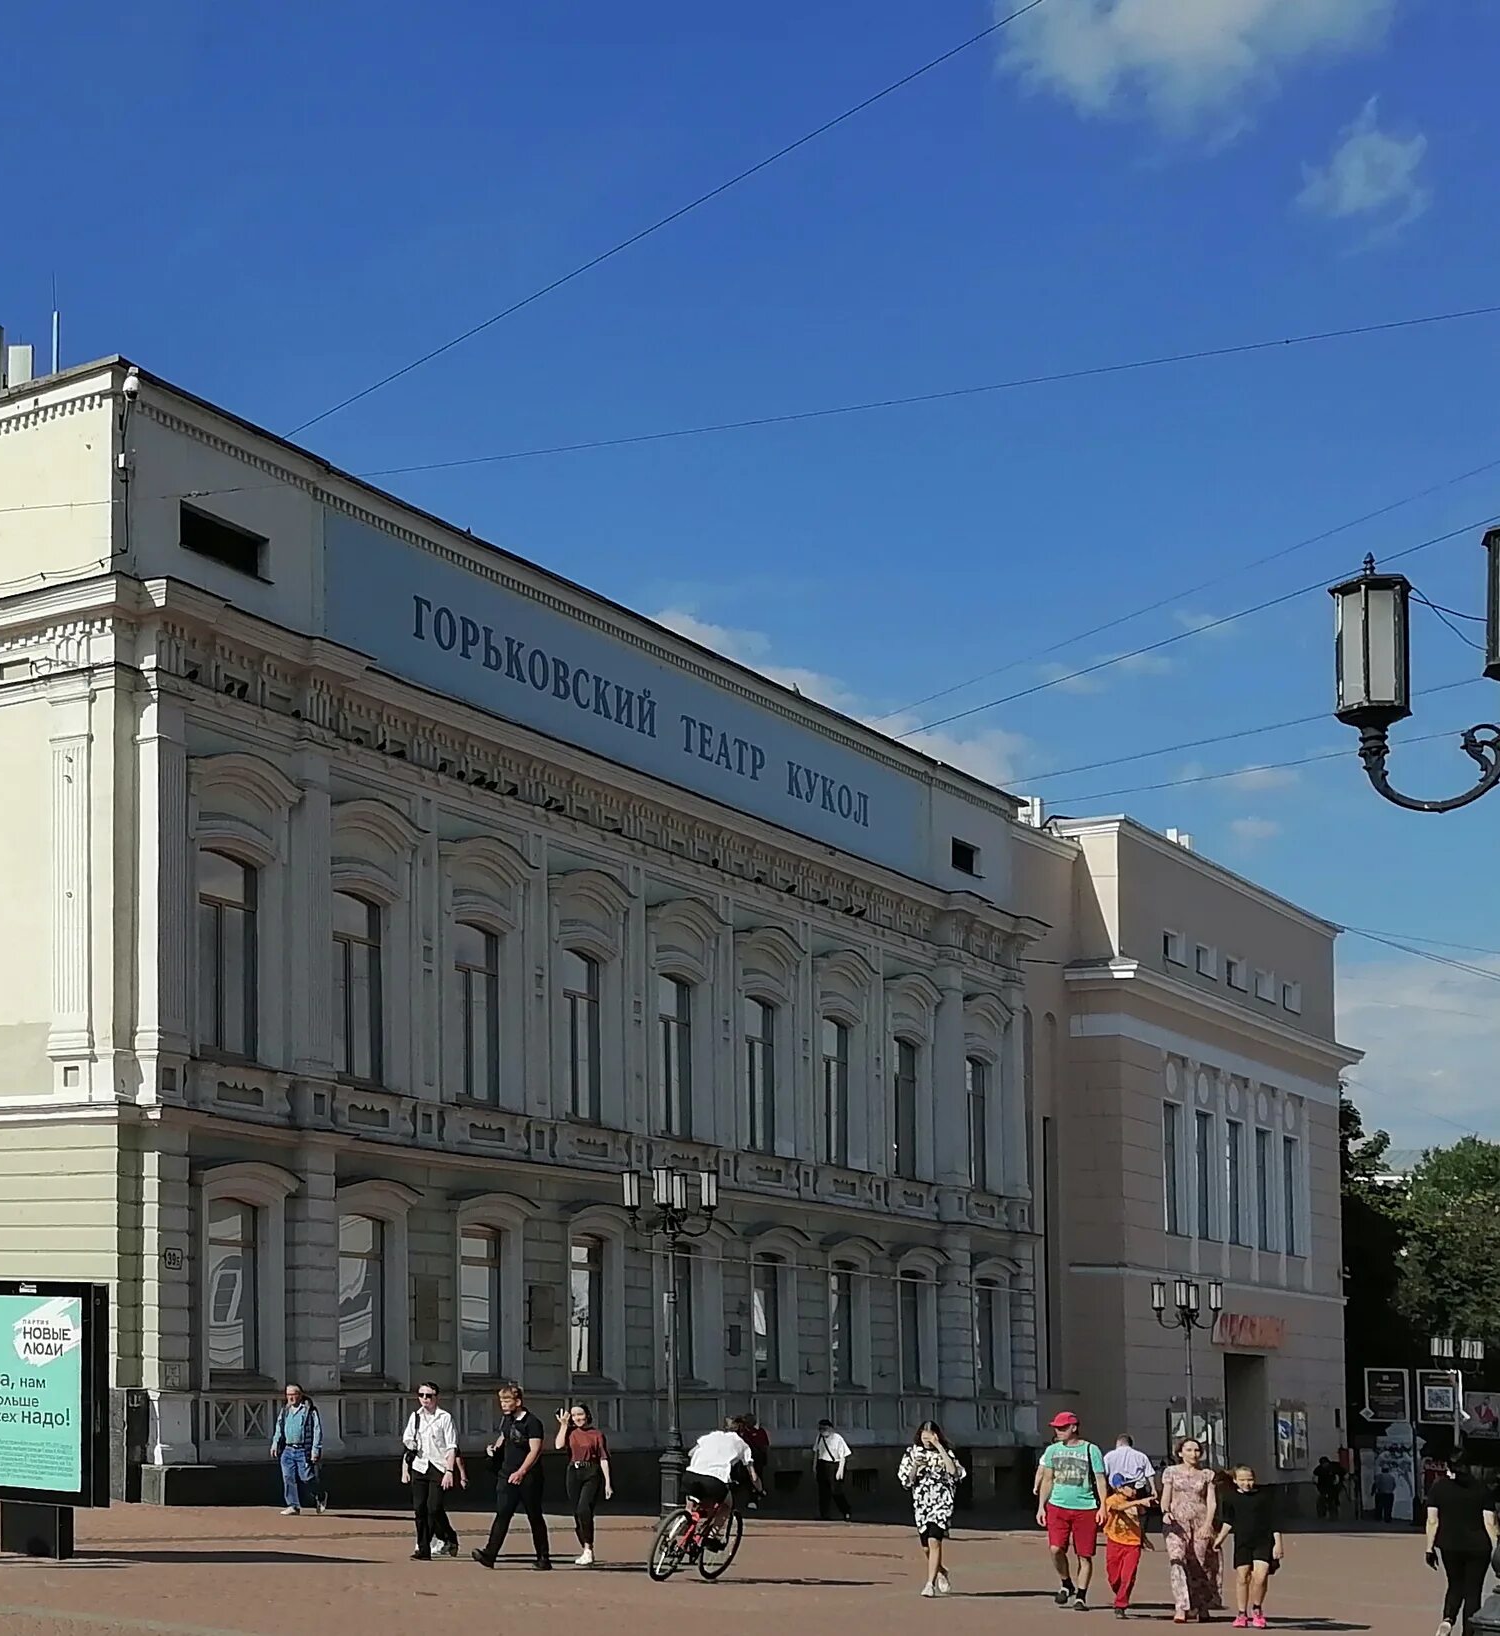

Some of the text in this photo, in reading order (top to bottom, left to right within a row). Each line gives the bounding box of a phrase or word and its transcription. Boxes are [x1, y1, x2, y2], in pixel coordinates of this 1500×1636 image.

[412, 594, 871, 828] ГОРЬКОВСКИЙ ТЕАТР КУКОЛ
[22, 1326, 71, 1341] НОВЫЕ
[23, 1342, 64, 1356] ЛЮДИ
[20, 1377, 46, 1389] нам
